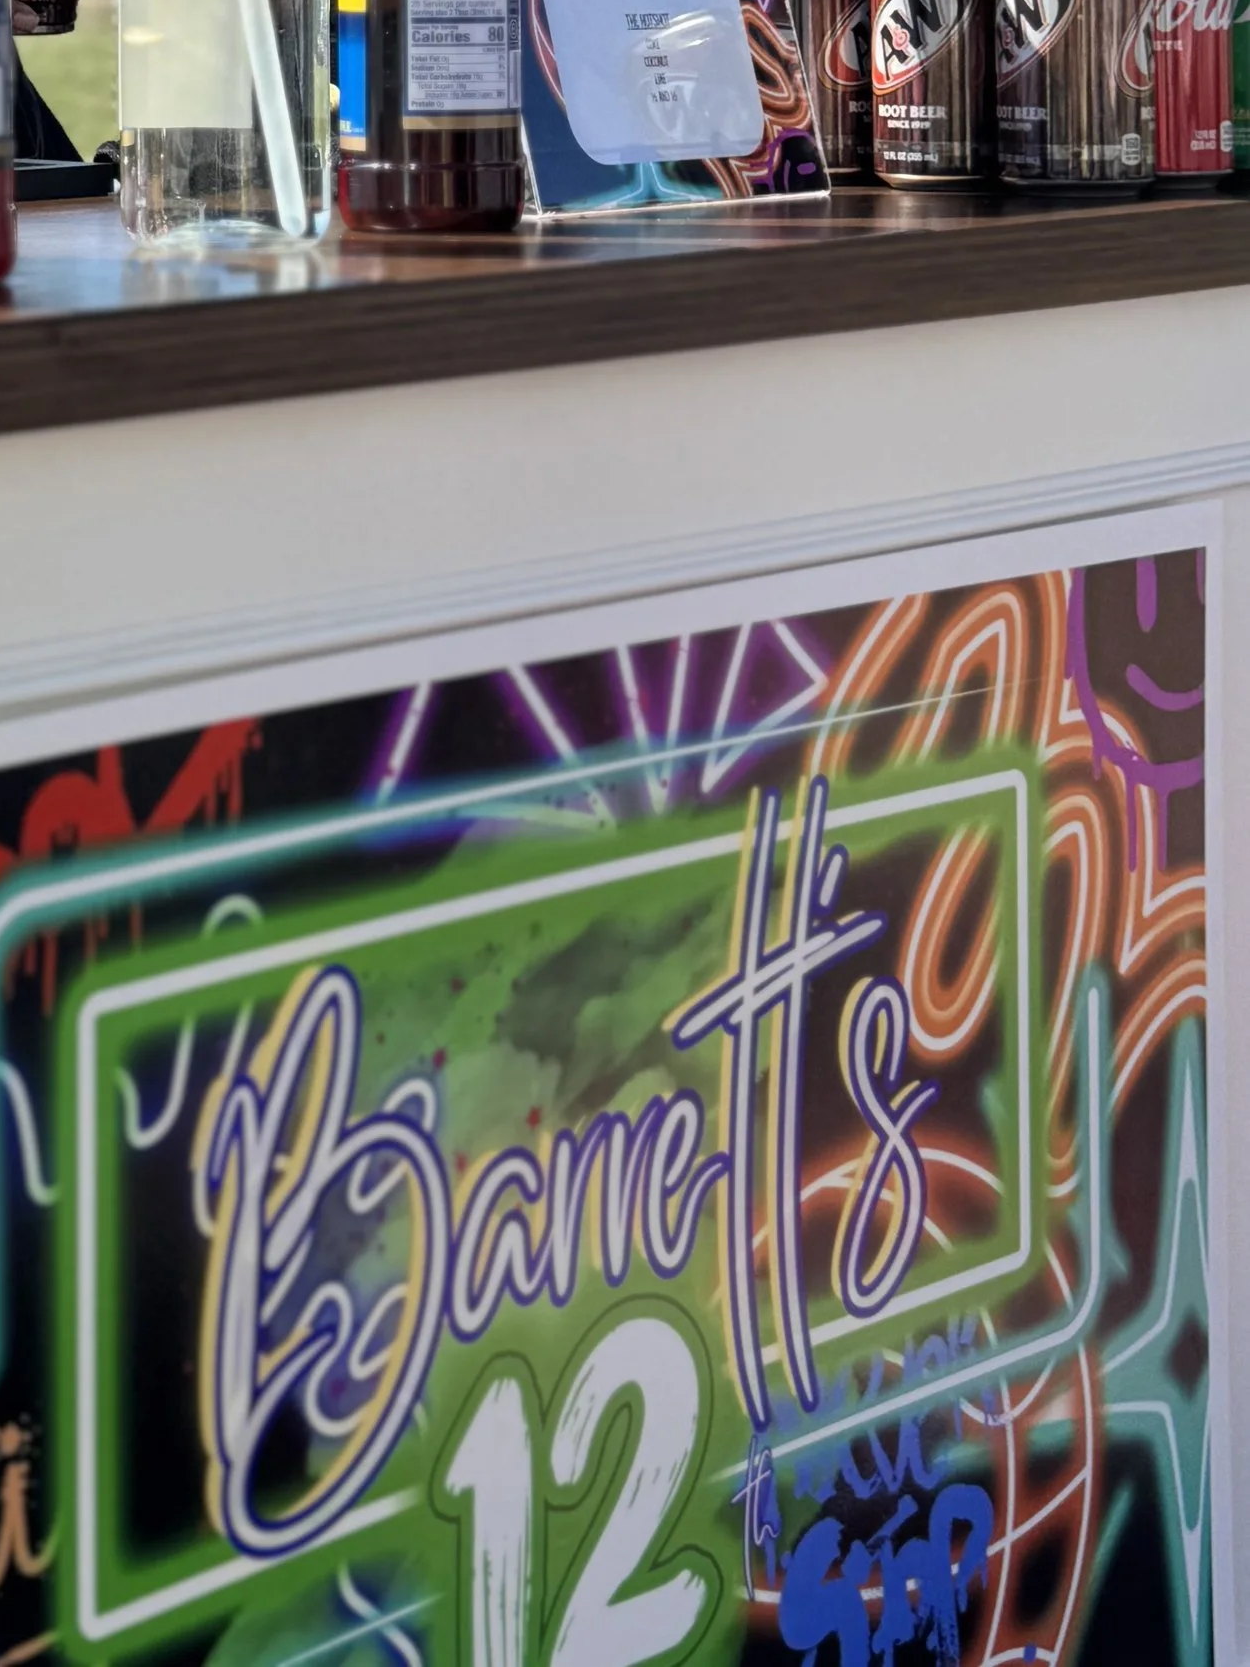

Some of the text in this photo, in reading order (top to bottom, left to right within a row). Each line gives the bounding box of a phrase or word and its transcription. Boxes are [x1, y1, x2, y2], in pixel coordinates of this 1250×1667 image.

[422, 0, 454, 9] Servings
[625, 14, 638, 28] THE
[411, 25, 505, 43] Calories 80
[644, 56, 669, 67] COCONUT
[429, 73, 472, 81] Carbohydrate
[878, 104, 947, 119] ROOT BEER
[1014, 107, 1048, 120] BEER
[887, 119, 932, 130] SINCE 1919
[898, 151, 906, 161] OZ
